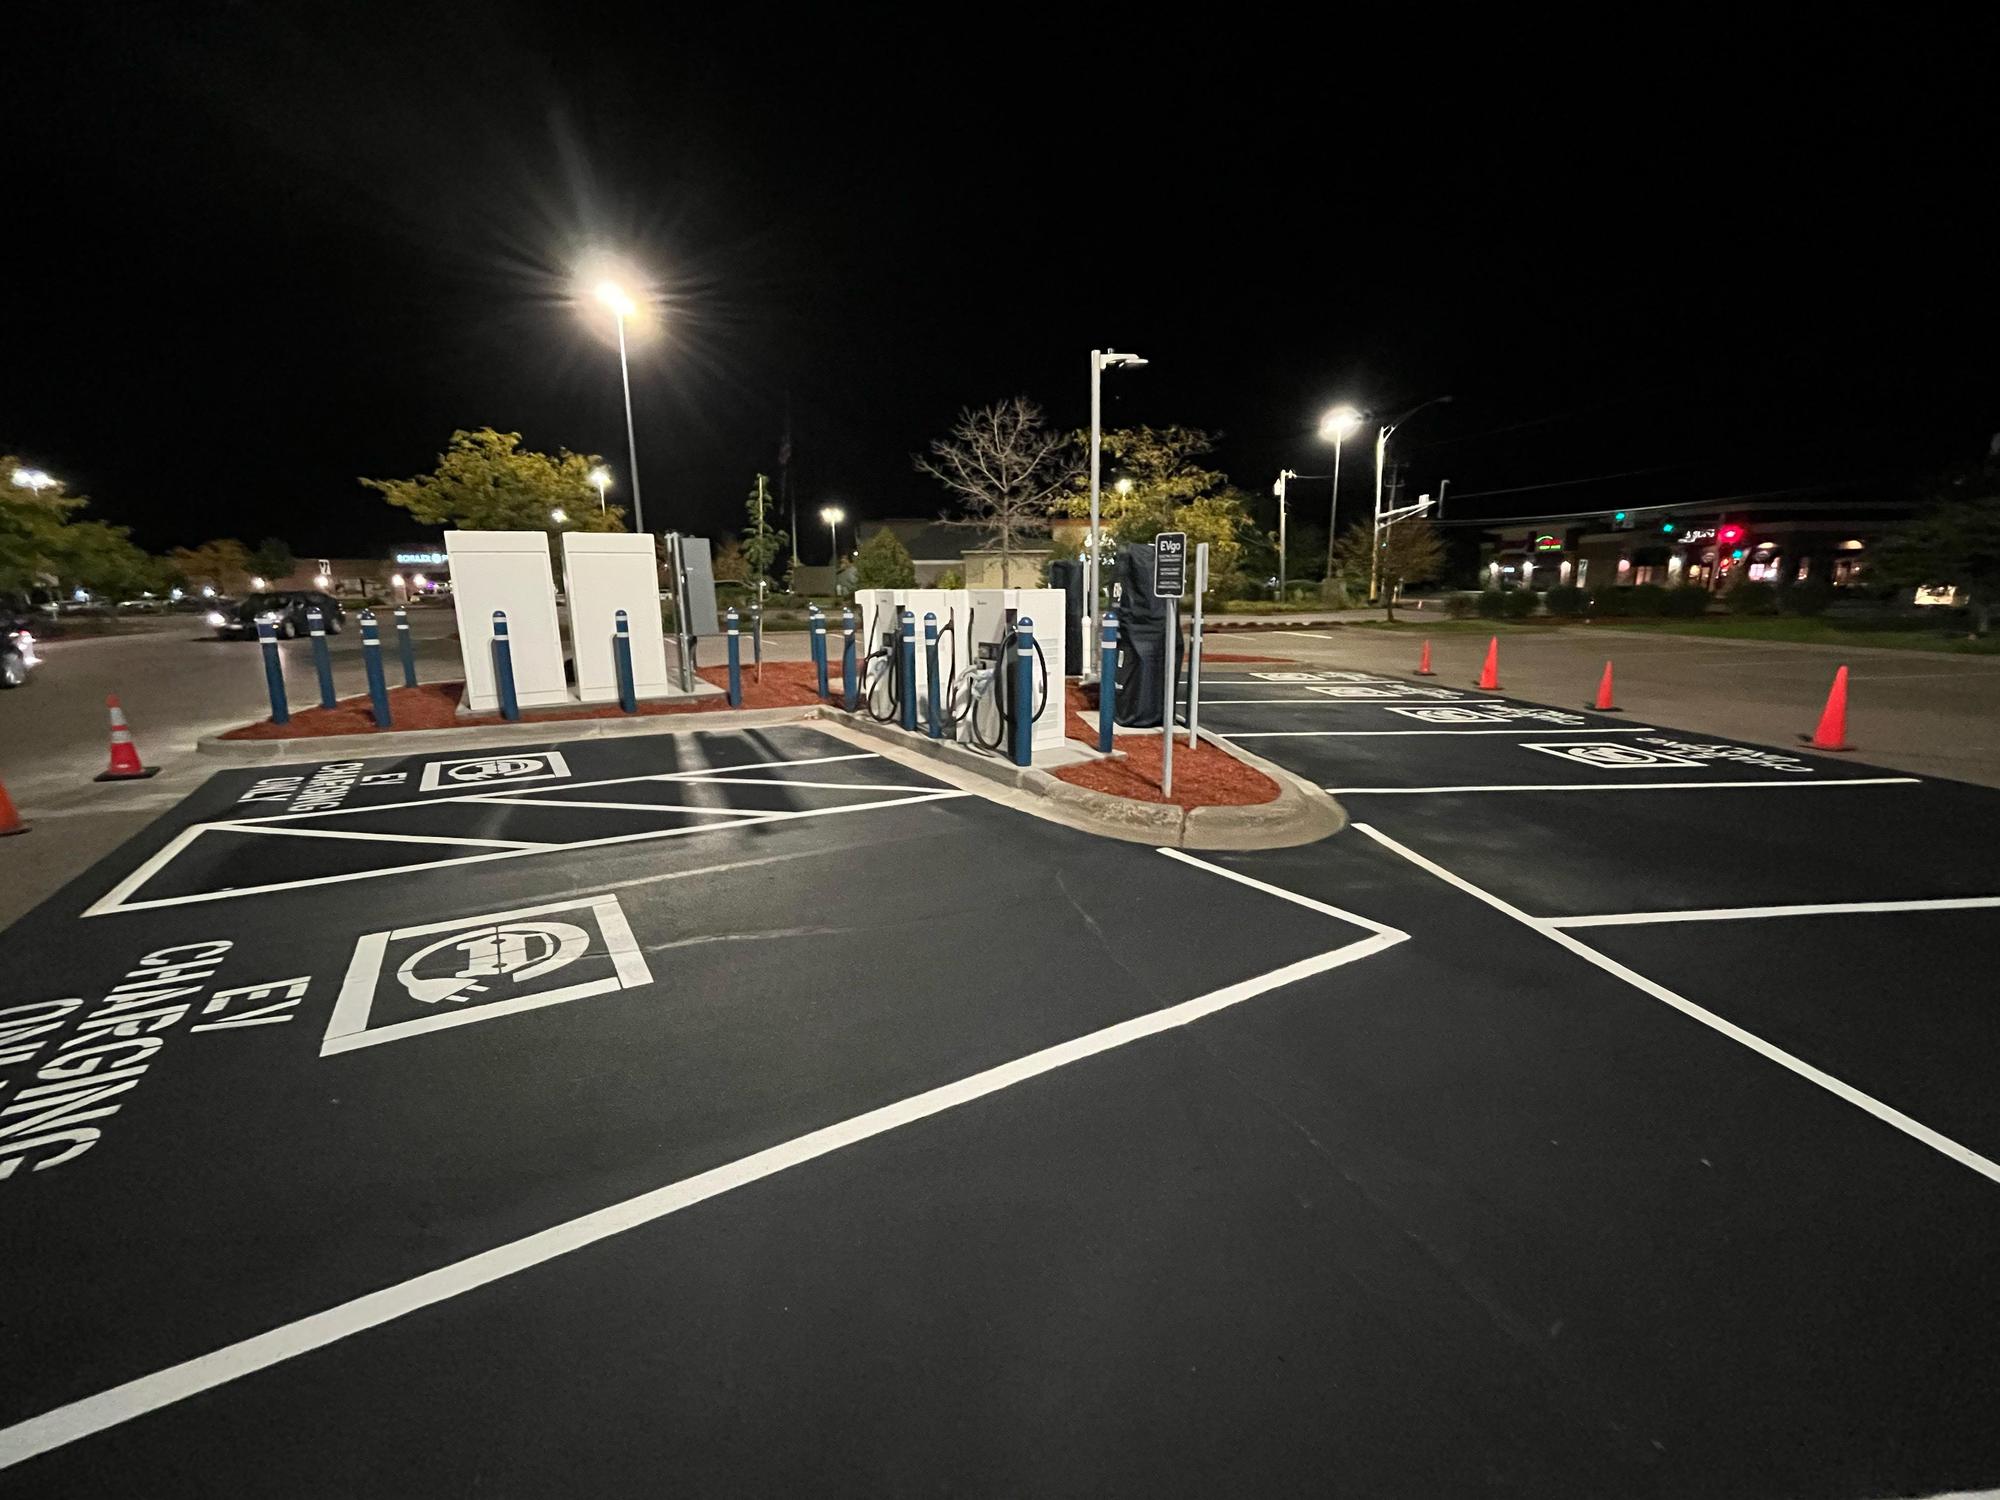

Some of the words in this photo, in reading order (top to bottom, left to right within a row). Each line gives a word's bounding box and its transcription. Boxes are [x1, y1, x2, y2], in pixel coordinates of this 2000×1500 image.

[1160, 541, 1181, 553] EVgo
[237, 777, 305, 803] ONLY
[288, 763, 364, 811] CHARGING
[360, 773, 408, 786] EV
[190, 976, 312, 1032] EV
[0, 940, 234, 1179] CHARGING
